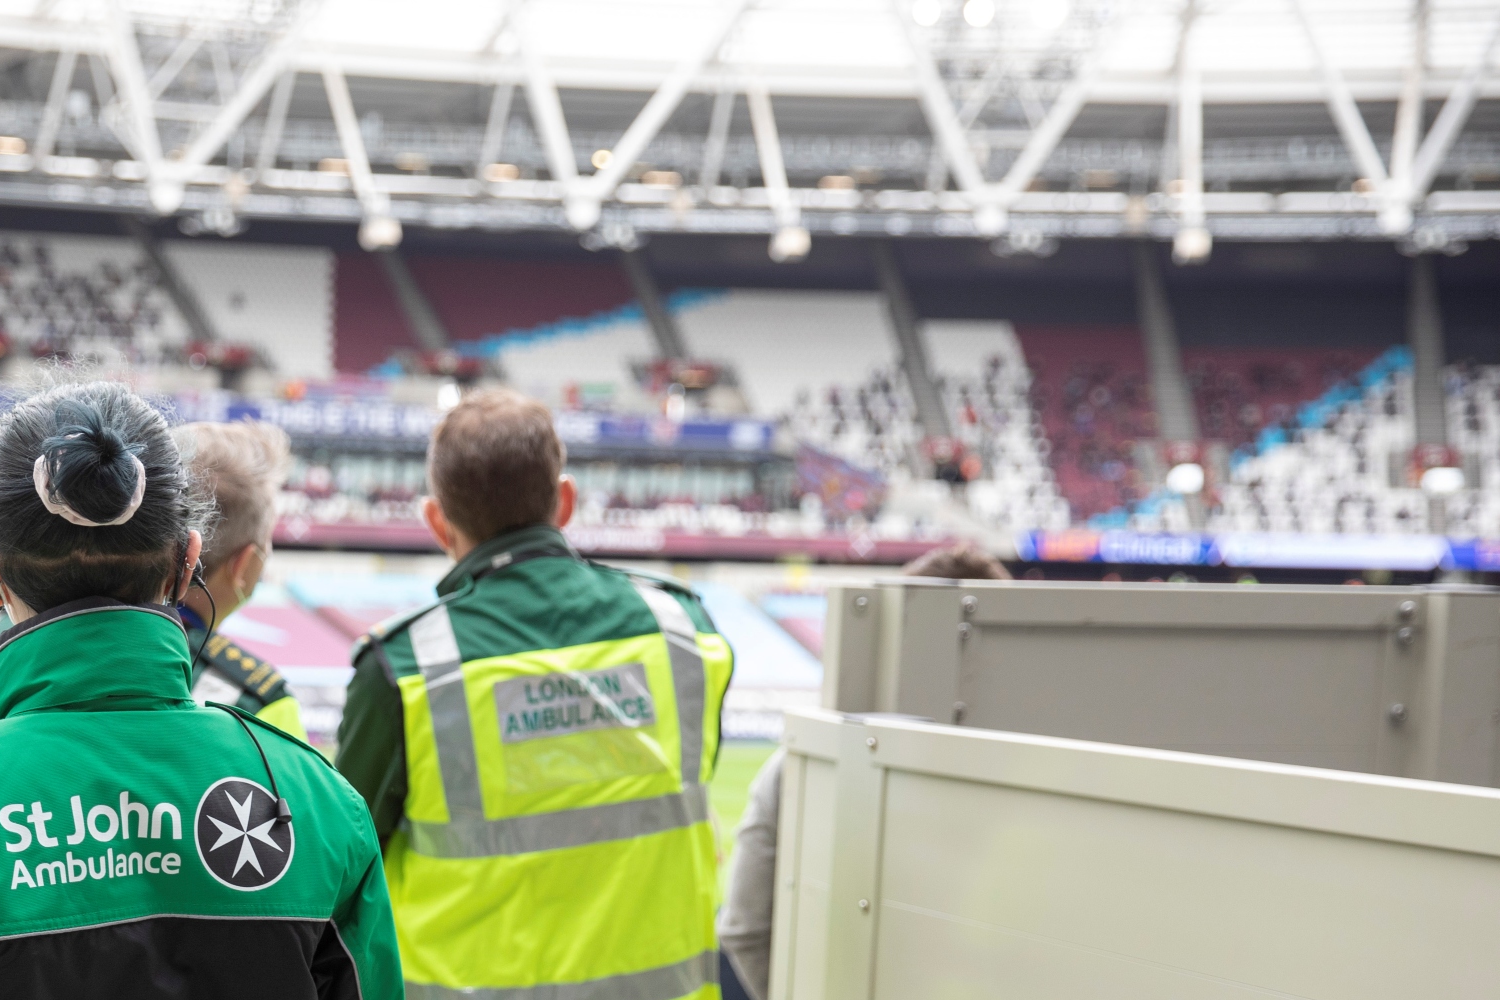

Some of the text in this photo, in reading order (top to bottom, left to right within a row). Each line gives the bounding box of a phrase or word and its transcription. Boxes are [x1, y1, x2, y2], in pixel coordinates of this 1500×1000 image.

[524, 672, 622, 705] LONDON
[505, 695, 651, 736] AMBULANCE
[66, 791, 182, 845] John
[10, 848, 182, 890] Ambulance
